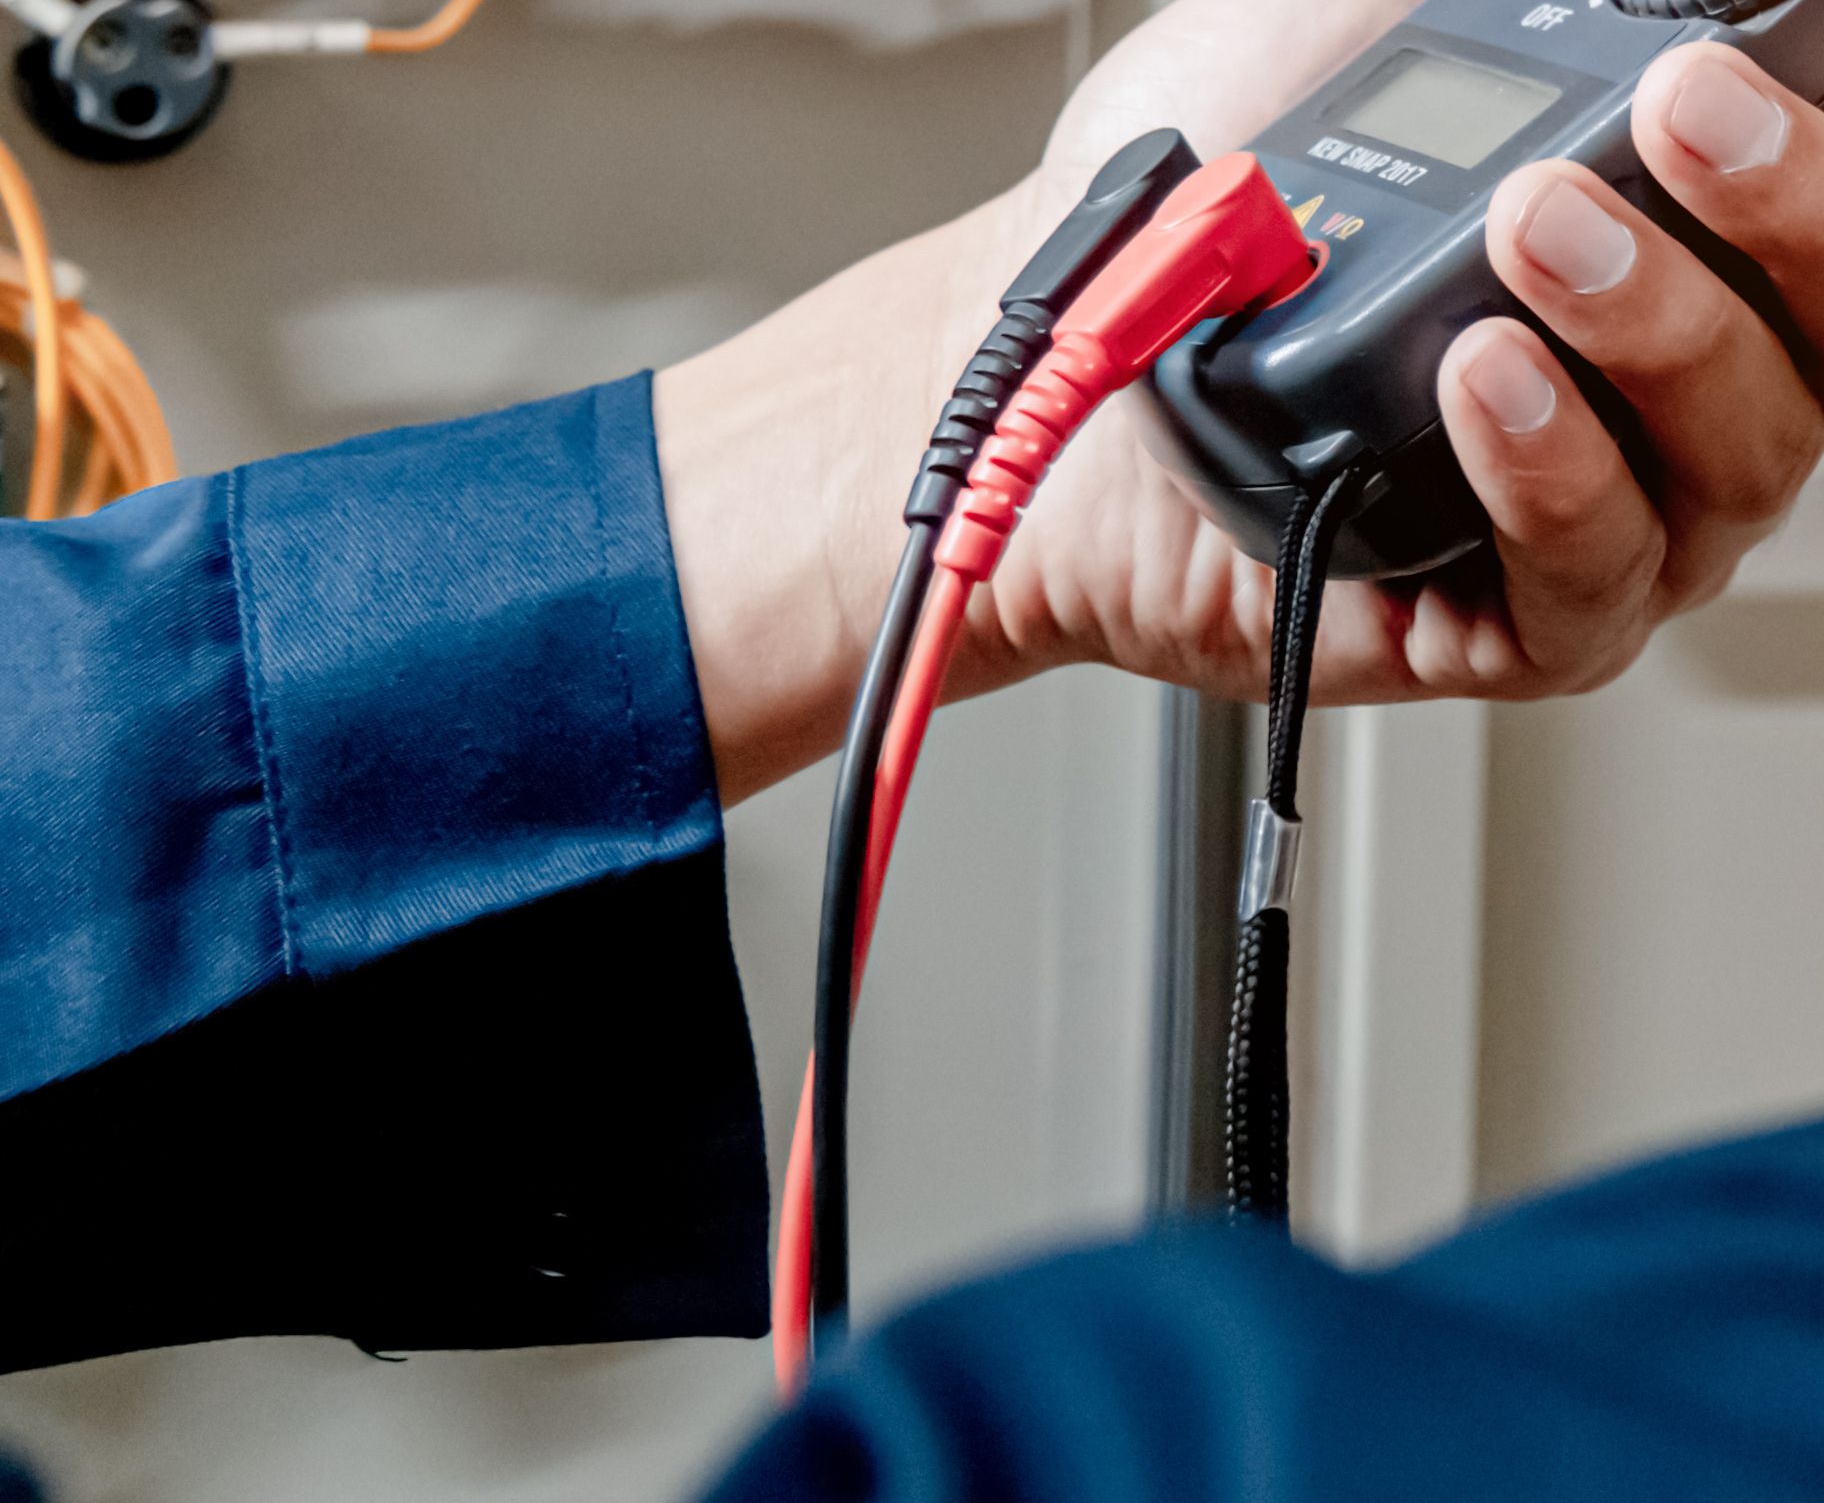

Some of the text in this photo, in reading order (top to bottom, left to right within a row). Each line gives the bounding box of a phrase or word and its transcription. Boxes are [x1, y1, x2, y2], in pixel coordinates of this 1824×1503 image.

[1521, 3, 1575, 31] OFF
[1306, 136, 1429, 187] KEW SNAP 2017
